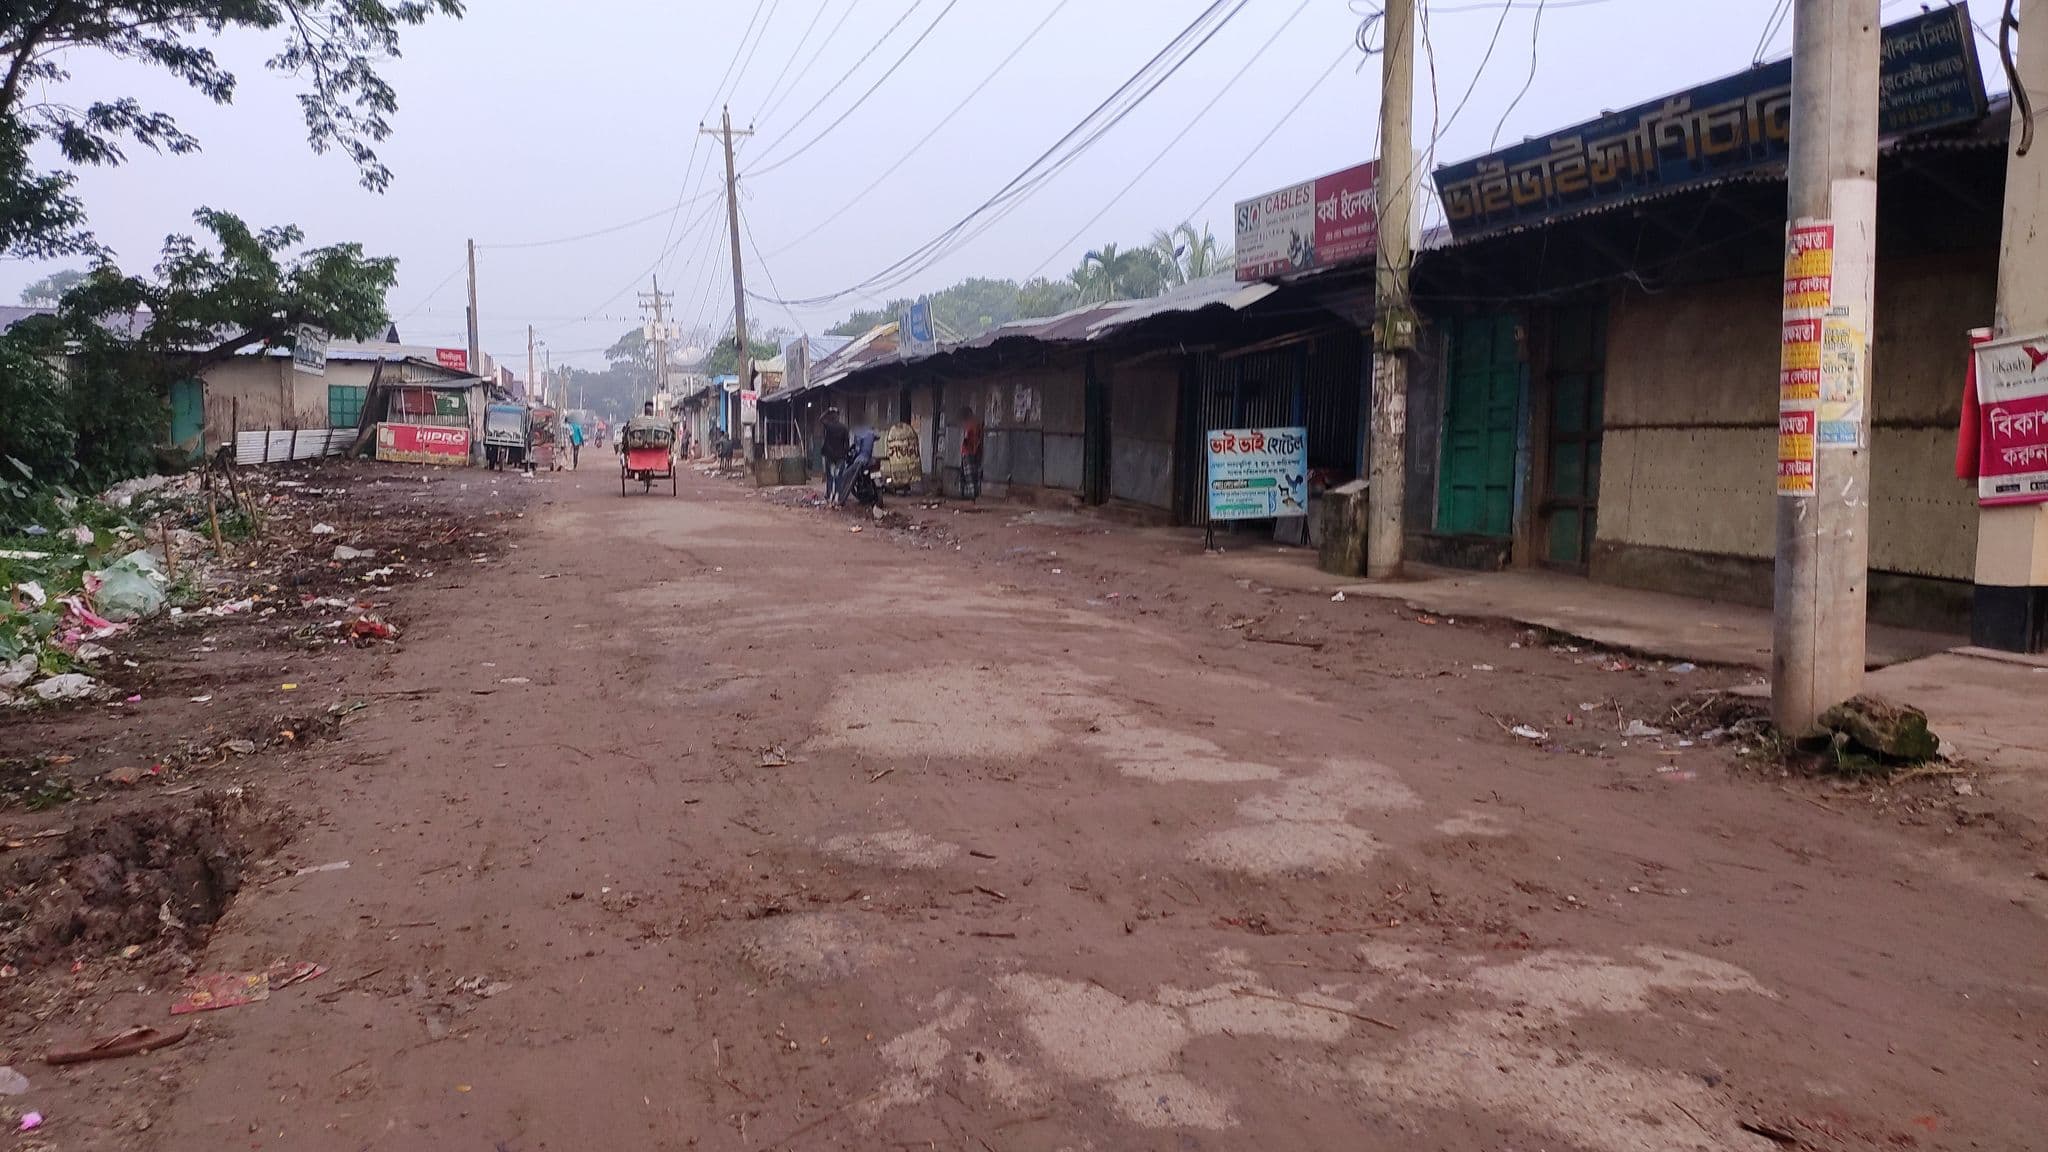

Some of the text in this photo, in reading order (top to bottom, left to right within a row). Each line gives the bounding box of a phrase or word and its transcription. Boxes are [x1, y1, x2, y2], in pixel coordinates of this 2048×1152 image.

[1265, 186, 1310, 214] CABLES
[1317, 191, 1338, 224] বর্ষা
[1209, 428, 1304, 456] ভাই ভাই হোটেল
